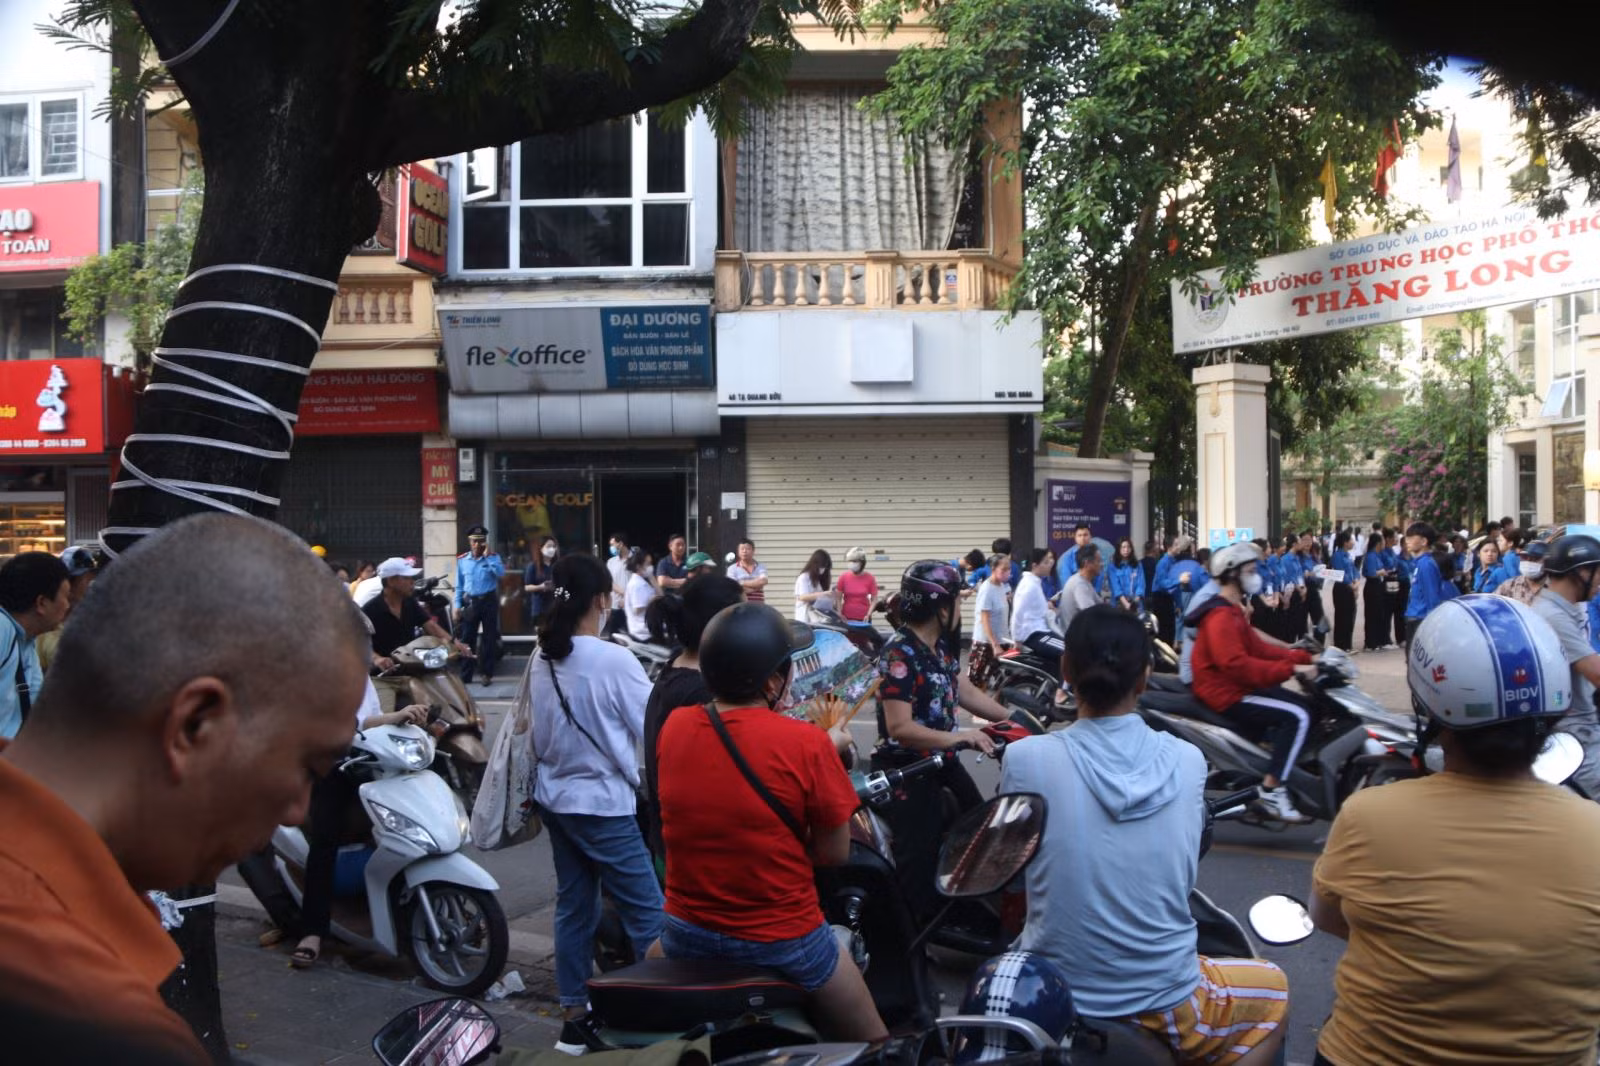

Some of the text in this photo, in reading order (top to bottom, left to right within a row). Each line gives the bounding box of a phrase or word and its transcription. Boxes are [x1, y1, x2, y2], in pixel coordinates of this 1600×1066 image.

[1, 235, 50, 255] TOÁN
[1329, 211, 1526, 261] SỞ GIÁO DỤC VÀ ĐÀO TẠO HÀ NỘI
[1330, 253, 1413, 281] TRUNG
[1420, 242, 1473, 264] HỌC
[1482, 219, 1538, 252] PHỔ
[1291, 250, 1573, 317] THĂNG LONG
[609, 311, 702, 329] ĐẠI DƯƠNG
[496, 492, 593, 506] OCEAN GOLF
[1414, 638, 1433, 669] BIDV
[1504, 686, 1539, 702] BIDV
